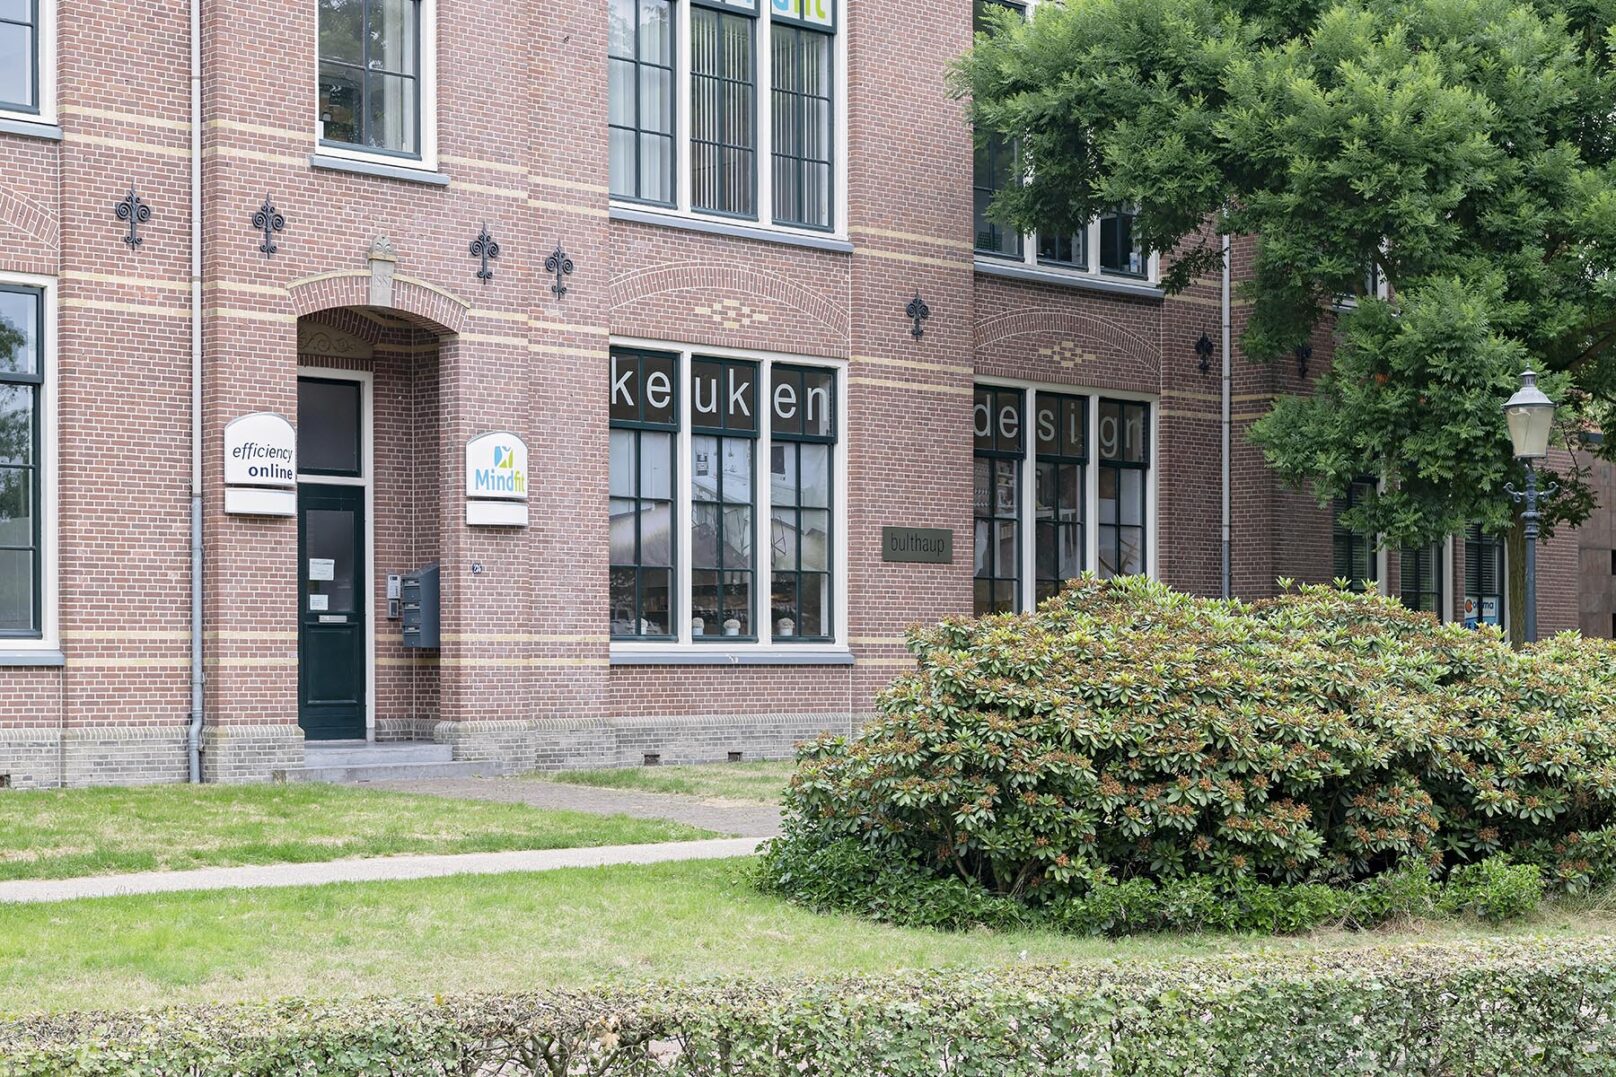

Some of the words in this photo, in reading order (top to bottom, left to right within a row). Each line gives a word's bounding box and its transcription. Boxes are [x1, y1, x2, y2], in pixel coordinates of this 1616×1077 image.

[611, 356, 828, 421] keuken
[974, 394, 1143, 458] design
[232, 442, 293, 463] efficiency
[248, 463, 293, 480] online
[475, 468, 525, 492] Mindfit
[890, 532, 945, 557] bulthaup
